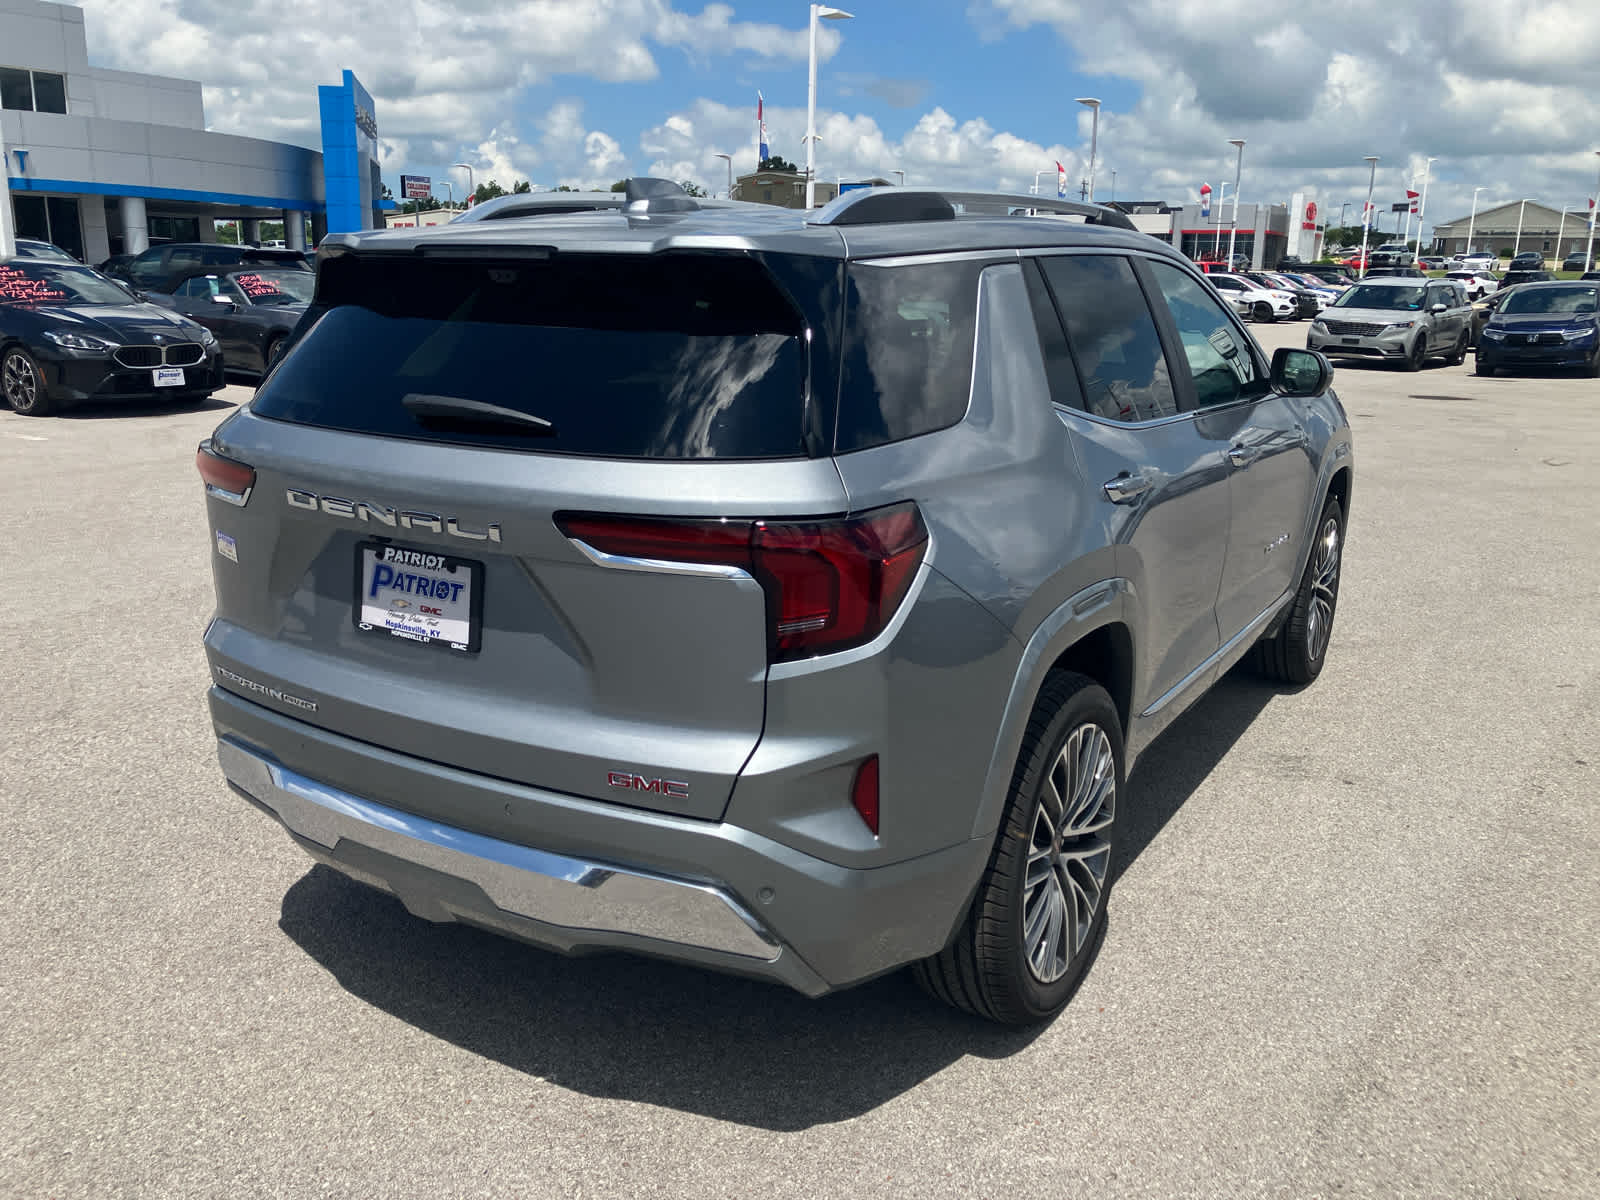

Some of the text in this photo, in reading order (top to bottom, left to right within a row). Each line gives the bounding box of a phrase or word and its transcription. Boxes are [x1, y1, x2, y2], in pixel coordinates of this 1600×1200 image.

[286, 488, 501, 542] DENALI
[384, 547, 446, 569] PATRIOT
[370, 563, 464, 602] PATRIOT
[420, 605, 443, 616] GMC
[385, 619, 441, 638] Hopkinsville, KY
[451, 642, 468, 651] GMC
[216, 665, 283, 701] TERRAIN
[608, 770, 689, 799] GMC
